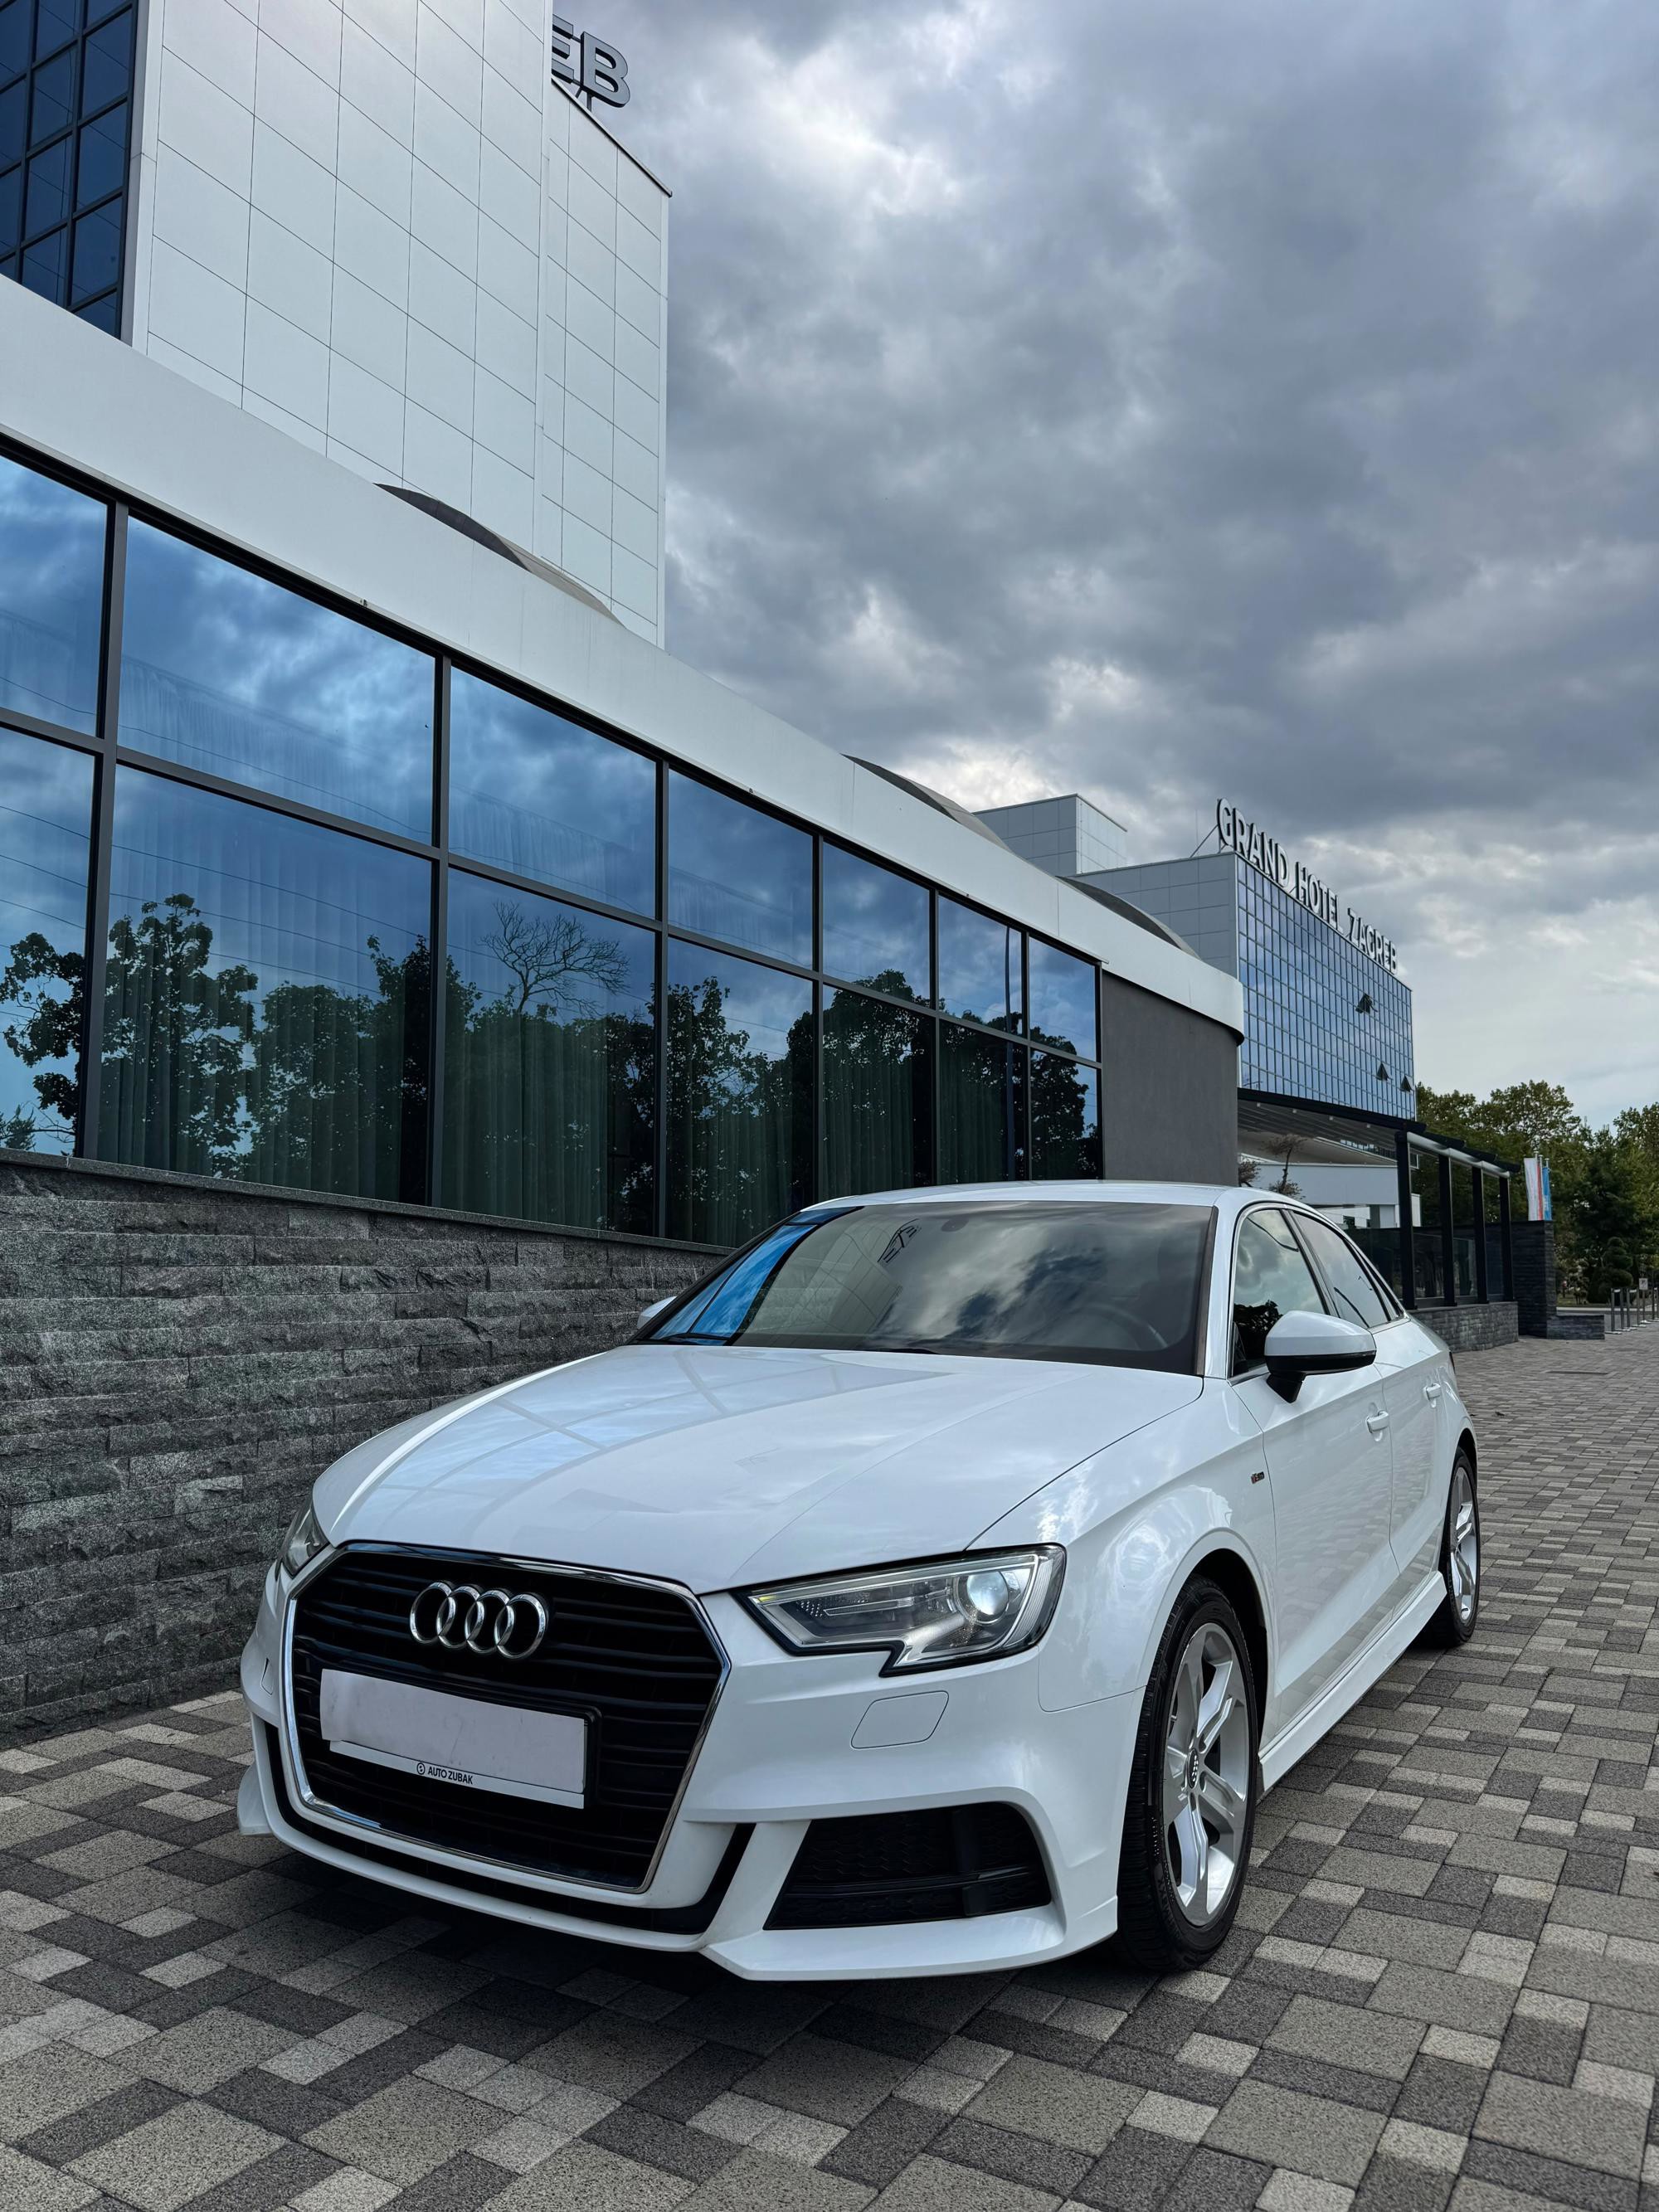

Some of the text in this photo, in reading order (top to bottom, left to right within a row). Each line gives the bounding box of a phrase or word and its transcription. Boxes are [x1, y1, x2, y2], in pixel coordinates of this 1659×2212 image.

[1217, 798, 1398, 975] GRAND HOTEL ZAGREB
[428, 1767, 473, 1784] AUTO ZUBAK
